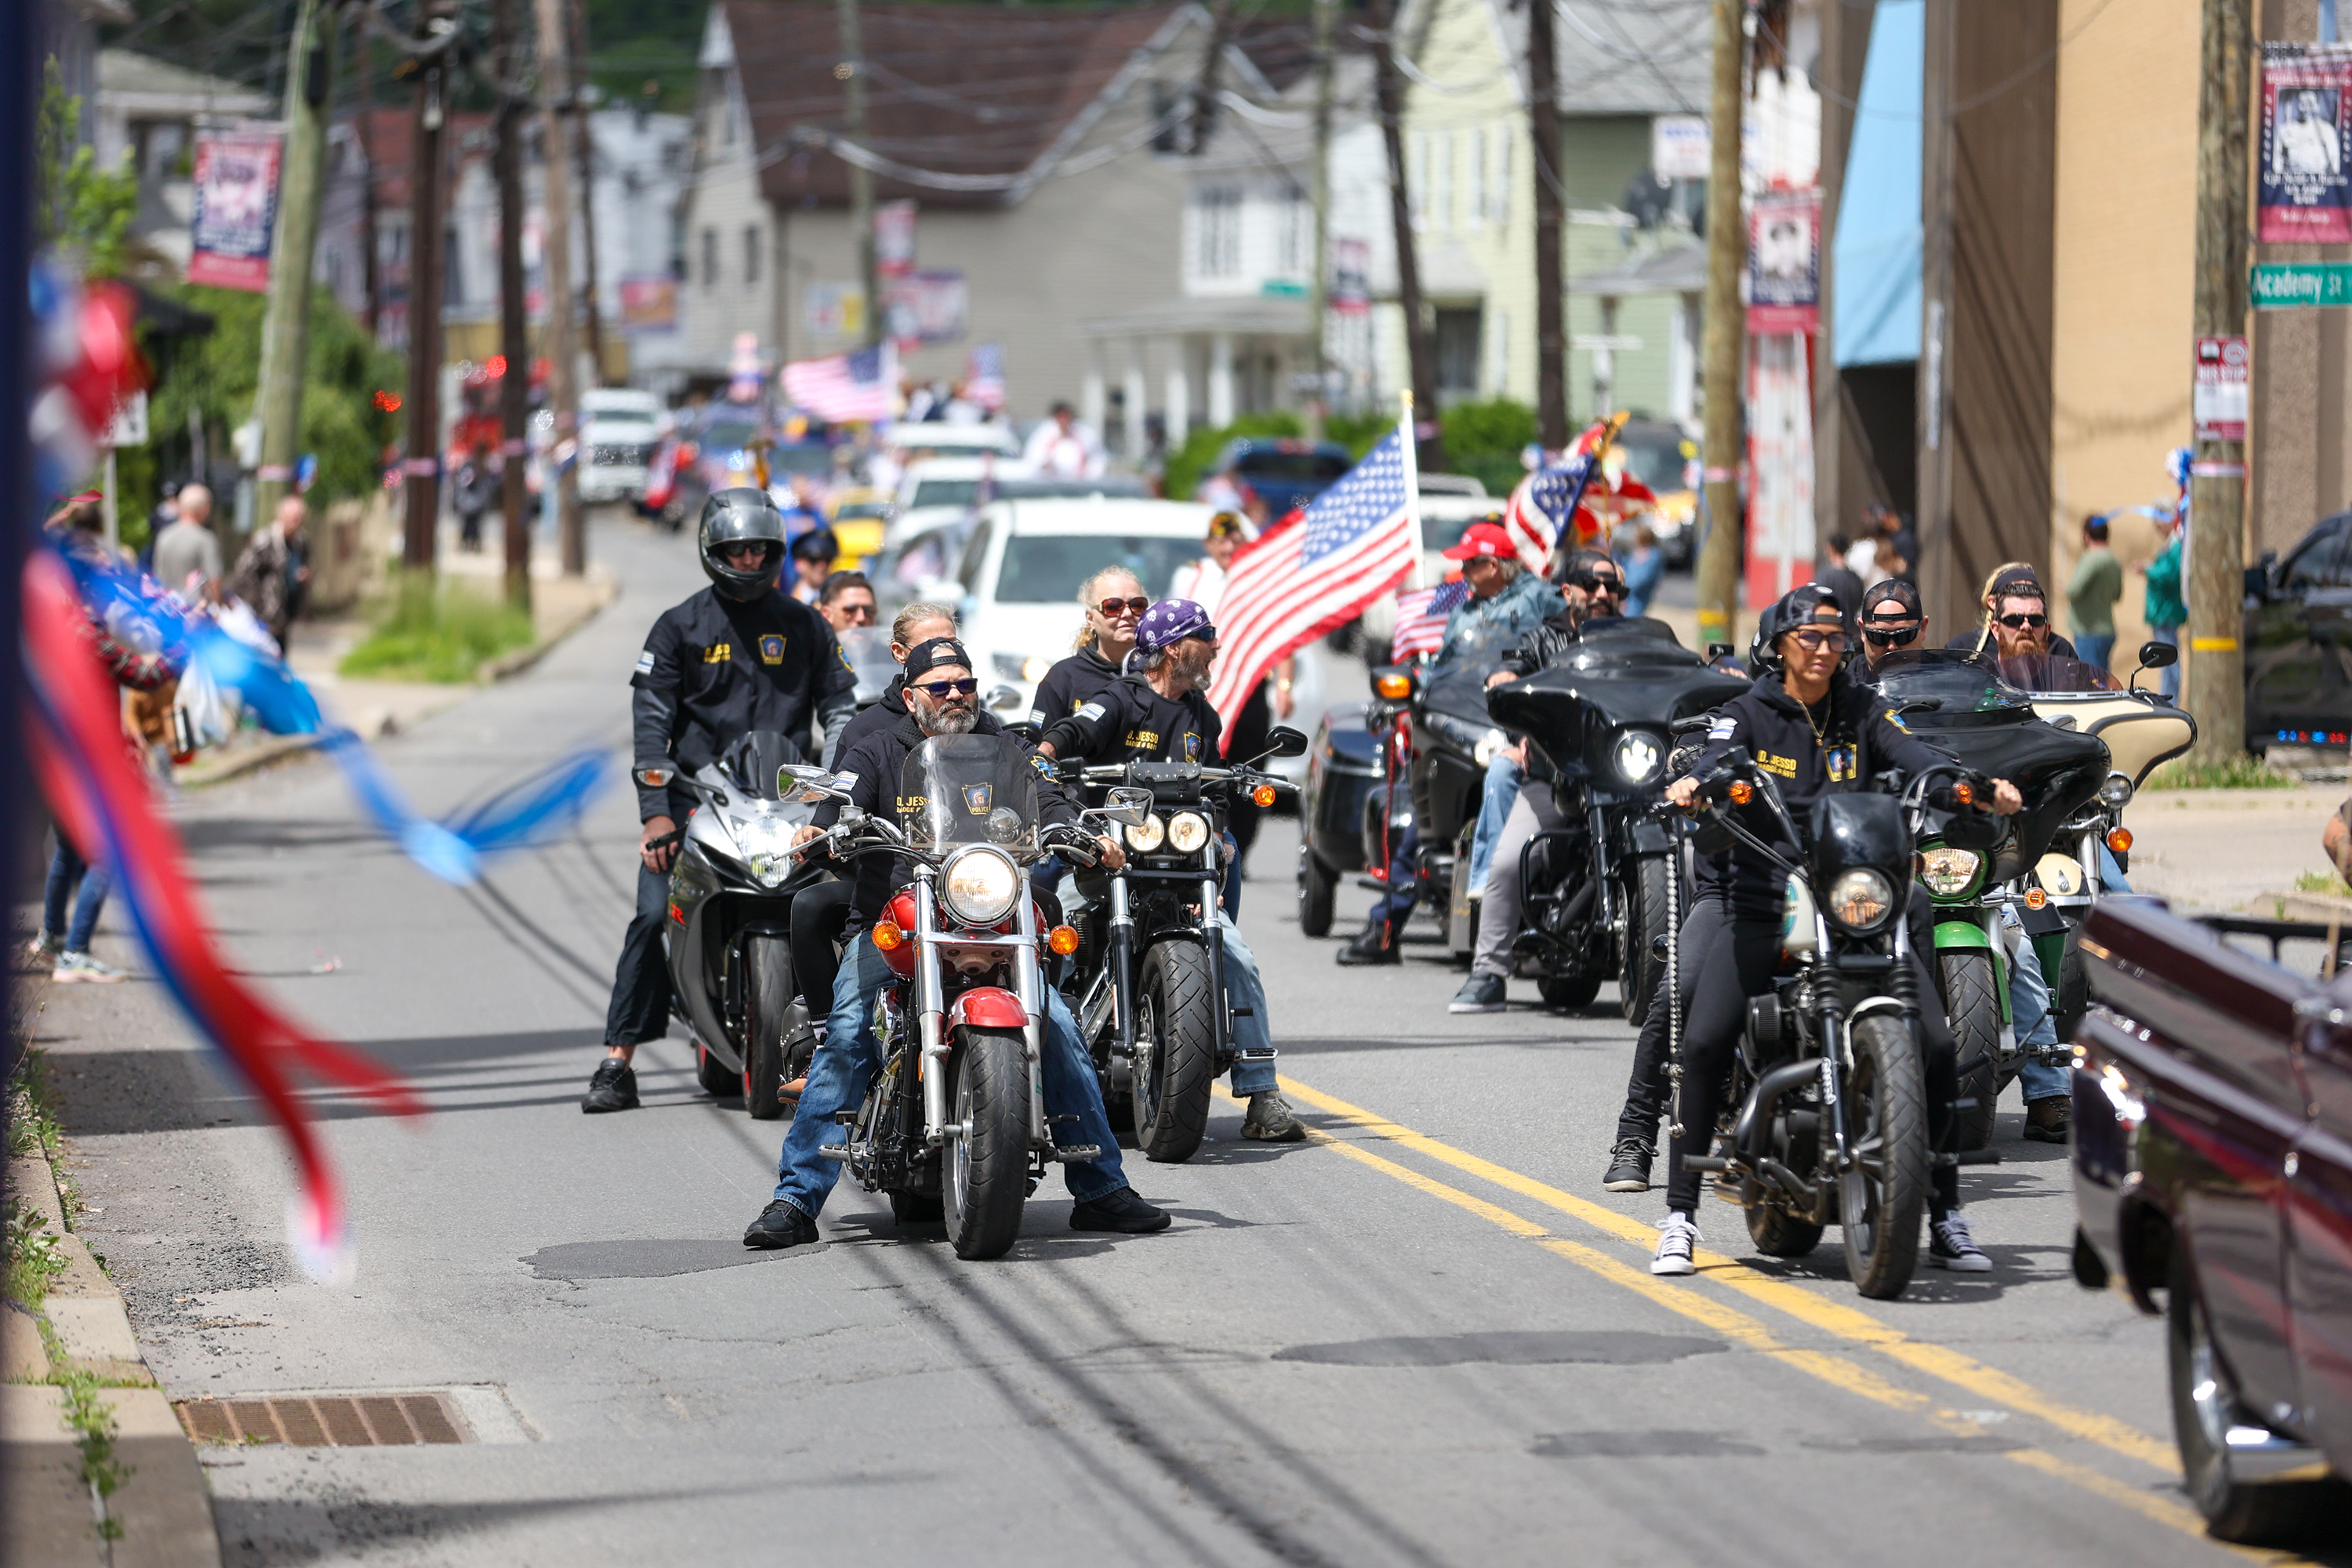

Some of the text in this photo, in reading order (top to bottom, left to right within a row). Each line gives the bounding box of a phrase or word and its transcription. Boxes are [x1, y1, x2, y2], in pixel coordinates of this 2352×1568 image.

[2252, 267, 2323, 304] Academy
[2327, 272, 2342, 296] St
[1126, 739, 1142, 748] BADGE
[1127, 730, 1159, 744] D. JESSO
[1757, 750, 1797, 771] D. JESSO
[896, 796, 904, 806] D.
